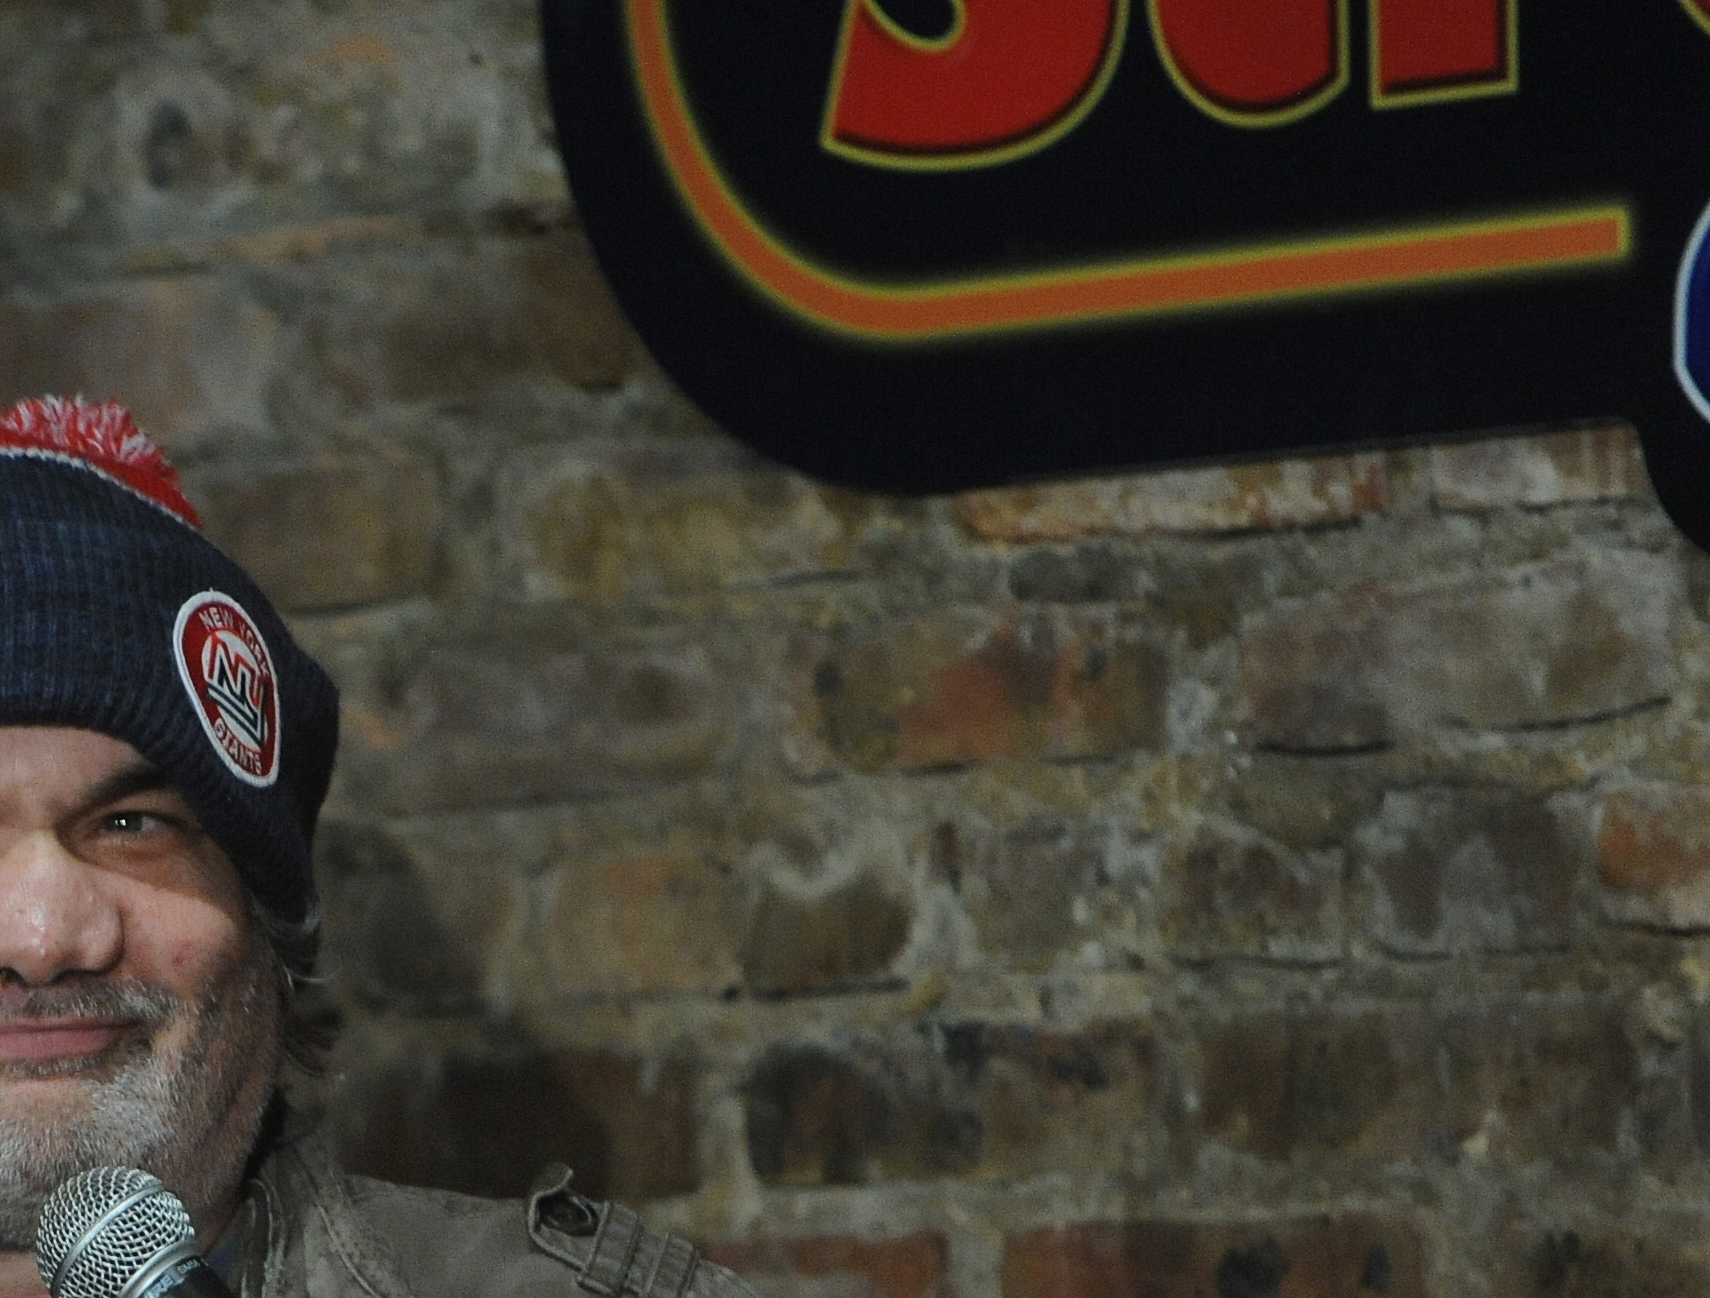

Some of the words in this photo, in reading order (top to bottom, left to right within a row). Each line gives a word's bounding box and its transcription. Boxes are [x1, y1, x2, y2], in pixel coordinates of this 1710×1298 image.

[198, 606, 234, 632] NEW
[239, 621, 269, 676] YORK
[214, 717, 262, 775] GIANTS
